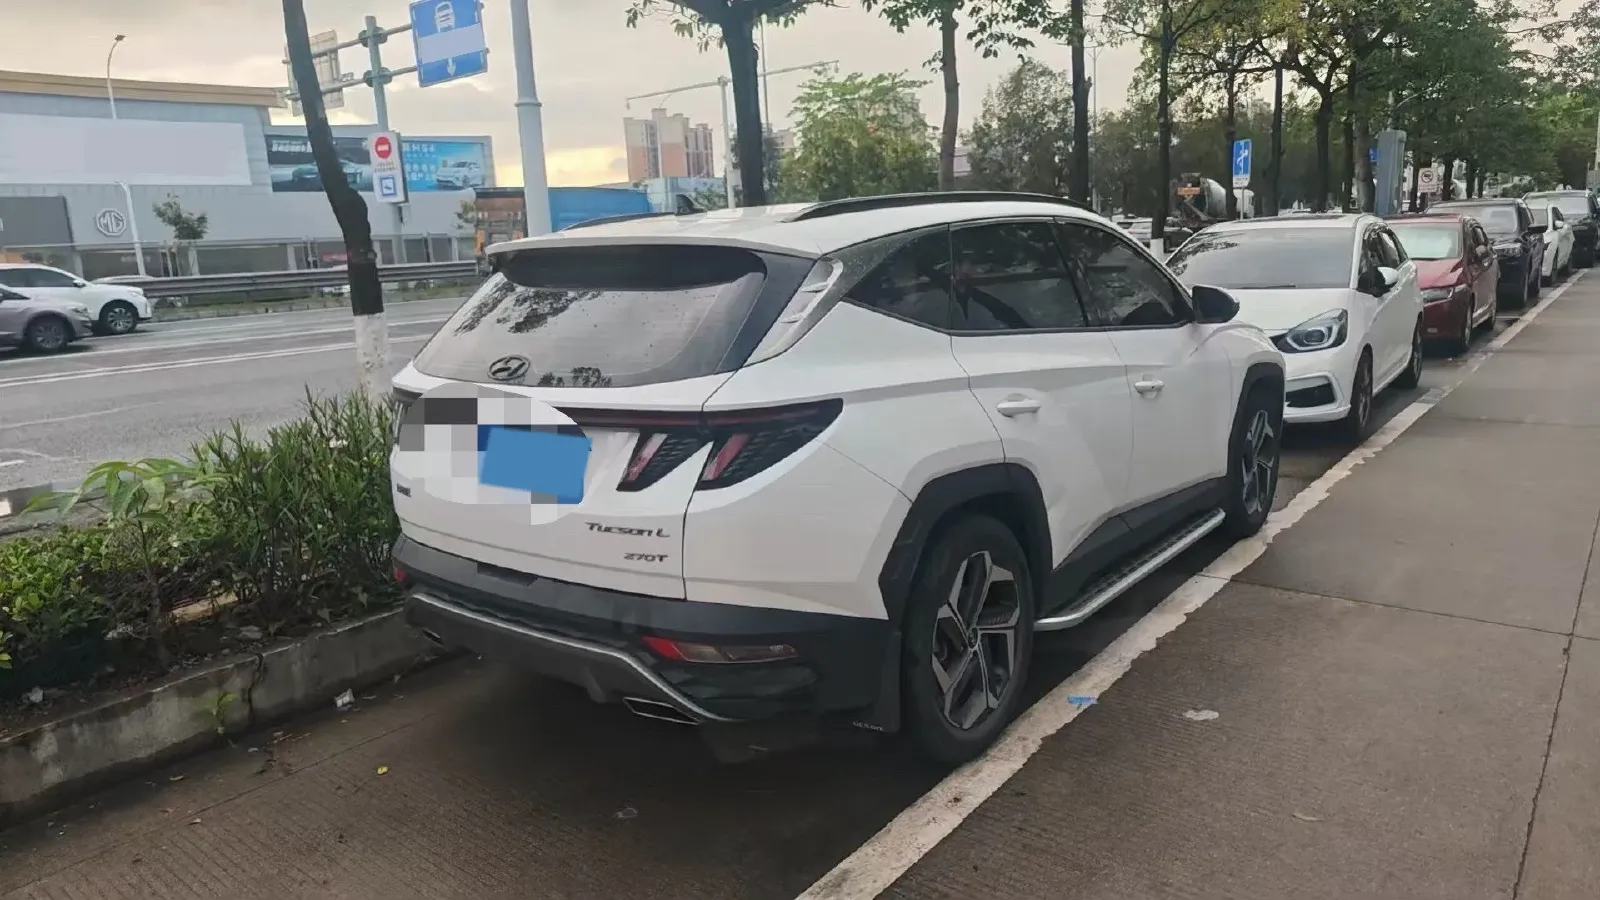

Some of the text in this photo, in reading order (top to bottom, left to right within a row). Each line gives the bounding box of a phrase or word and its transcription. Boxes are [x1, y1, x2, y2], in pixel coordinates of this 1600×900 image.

[99, 210, 124, 234] MG
[656, 528, 670, 538] L
[624, 553, 668, 562] 270T
